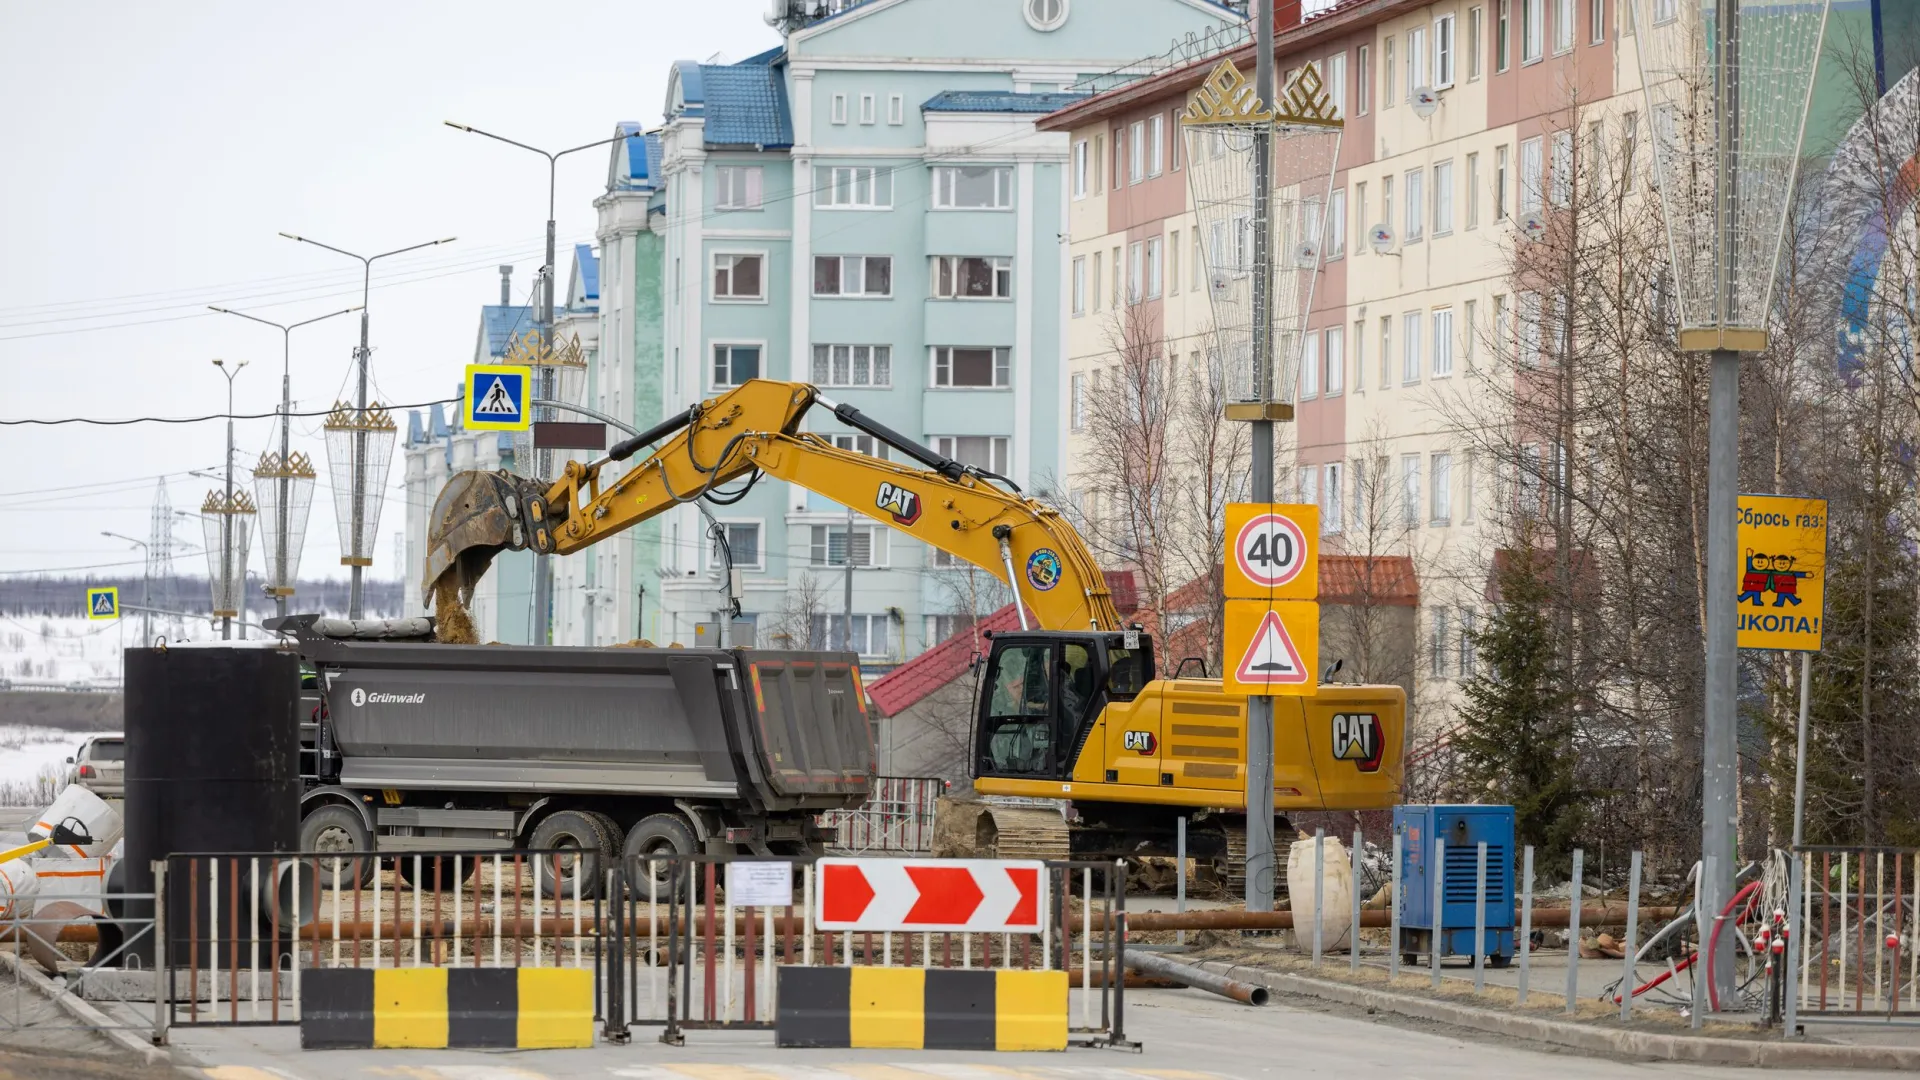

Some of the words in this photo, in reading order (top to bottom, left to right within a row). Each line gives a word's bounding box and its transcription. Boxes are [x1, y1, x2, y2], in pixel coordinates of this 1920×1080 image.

[877, 483, 914, 517] CAT
[1247, 532, 1293, 567] 40
[368, 692, 425, 703] Grünwald
[1124, 731, 1150, 750] CAT
[1332, 714, 1373, 759] CAT
